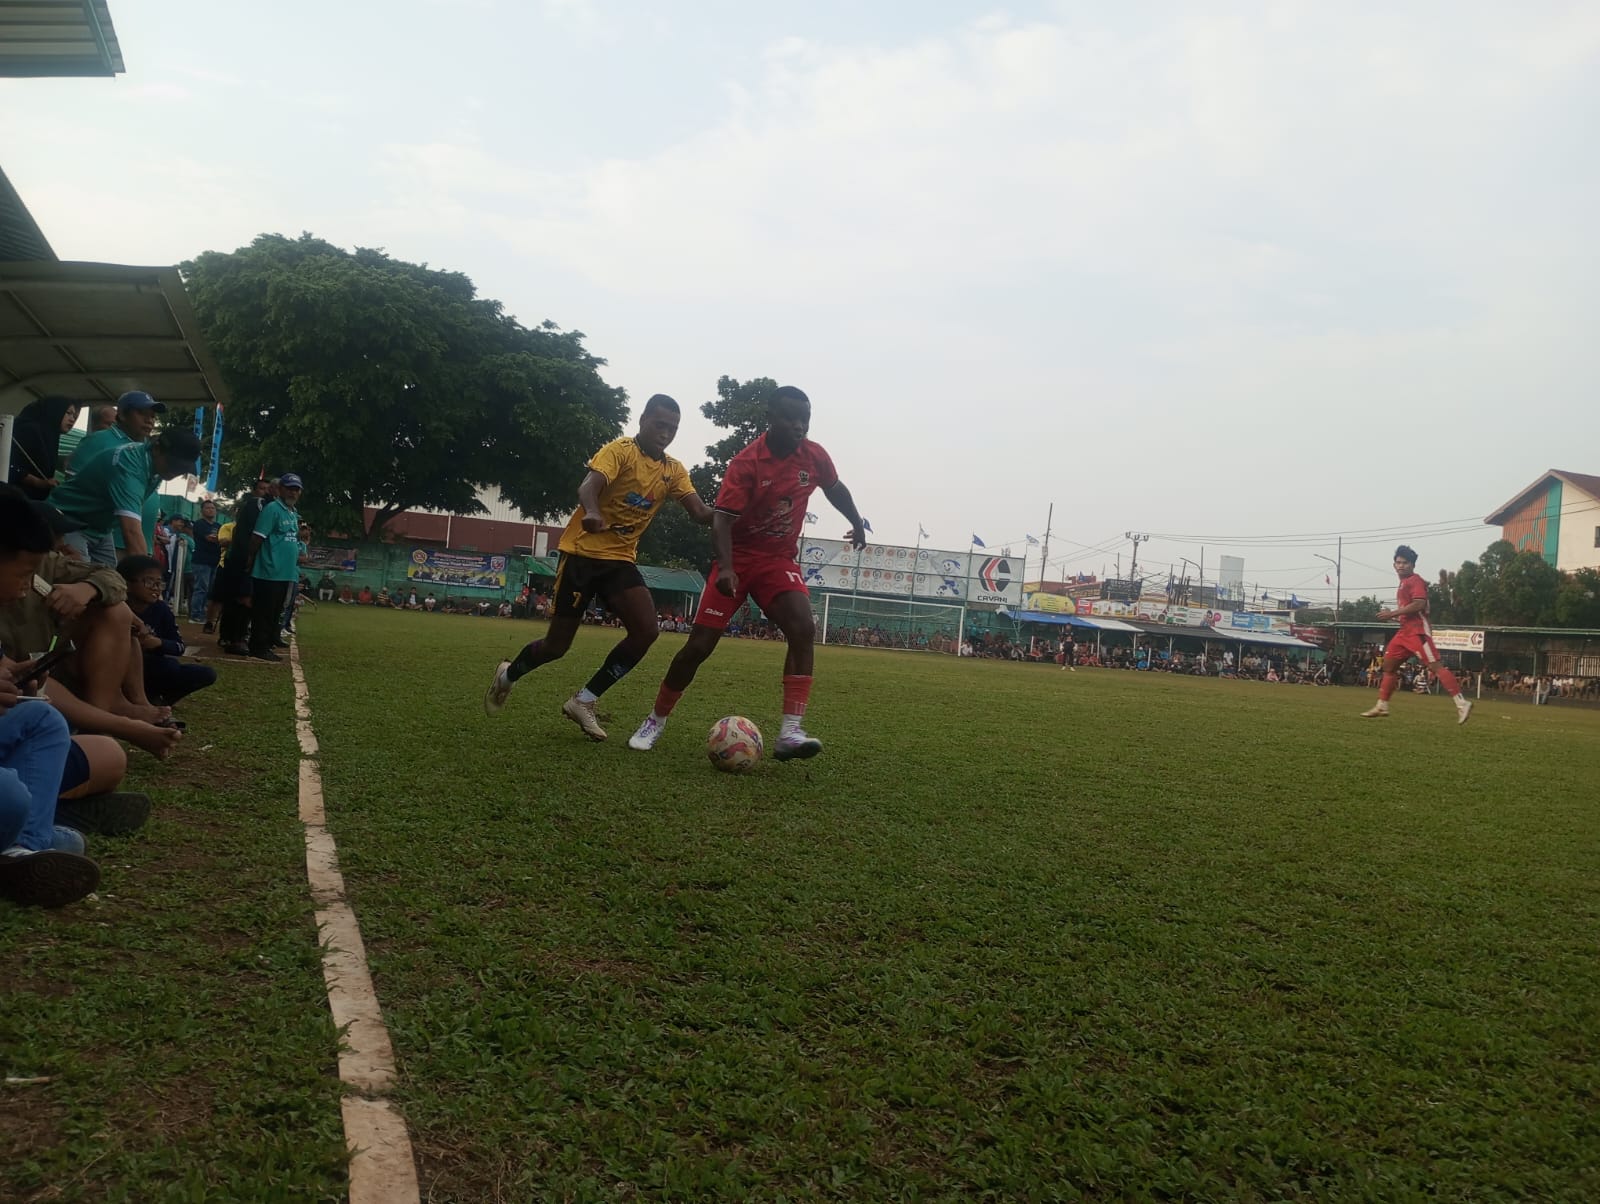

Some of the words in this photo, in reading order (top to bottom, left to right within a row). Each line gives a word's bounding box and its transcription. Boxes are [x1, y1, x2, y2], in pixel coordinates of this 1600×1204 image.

[785, 570, 804, 585] 17
[572, 591, 582, 608] 7
[977, 595, 1008, 603] CAVANI
